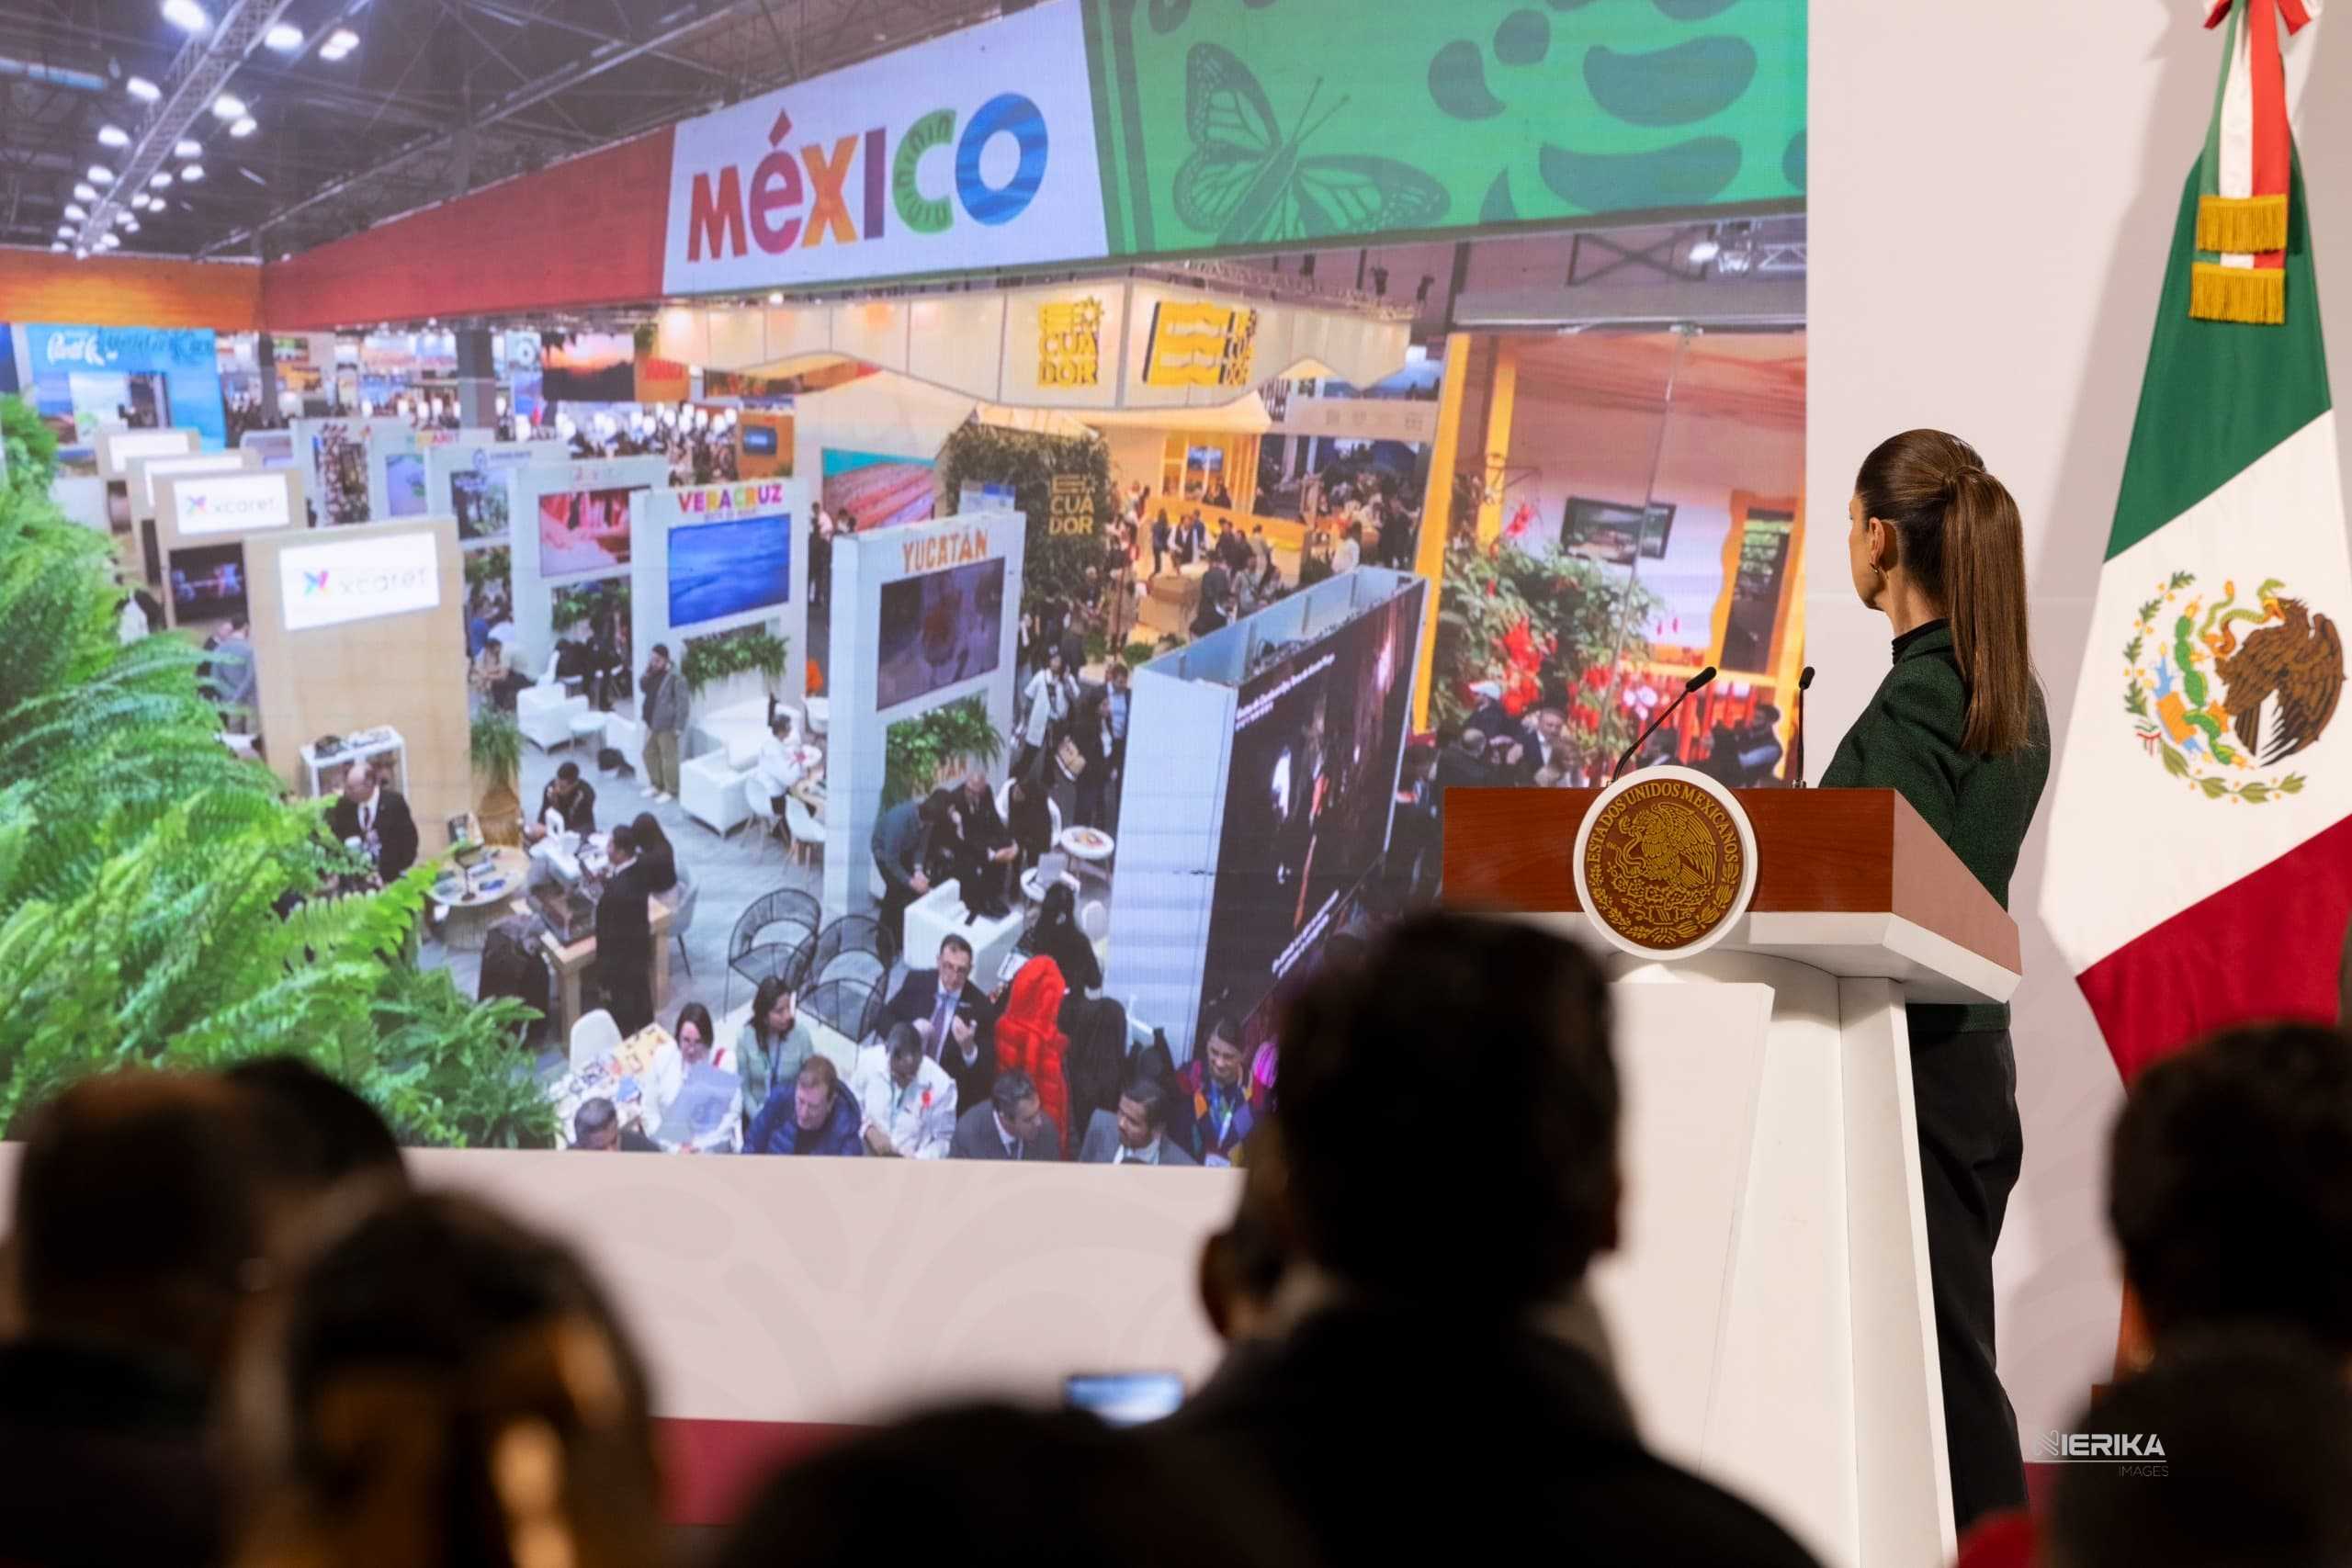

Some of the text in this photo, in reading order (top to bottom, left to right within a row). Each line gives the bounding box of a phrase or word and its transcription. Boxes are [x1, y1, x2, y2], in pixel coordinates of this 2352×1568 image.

[677, 484, 782, 513] VERACRUZ
[338, 566, 427, 595] xcaret
[1588, 782, 1740, 863] ESTADOS UNIDOS MEXICANOS
